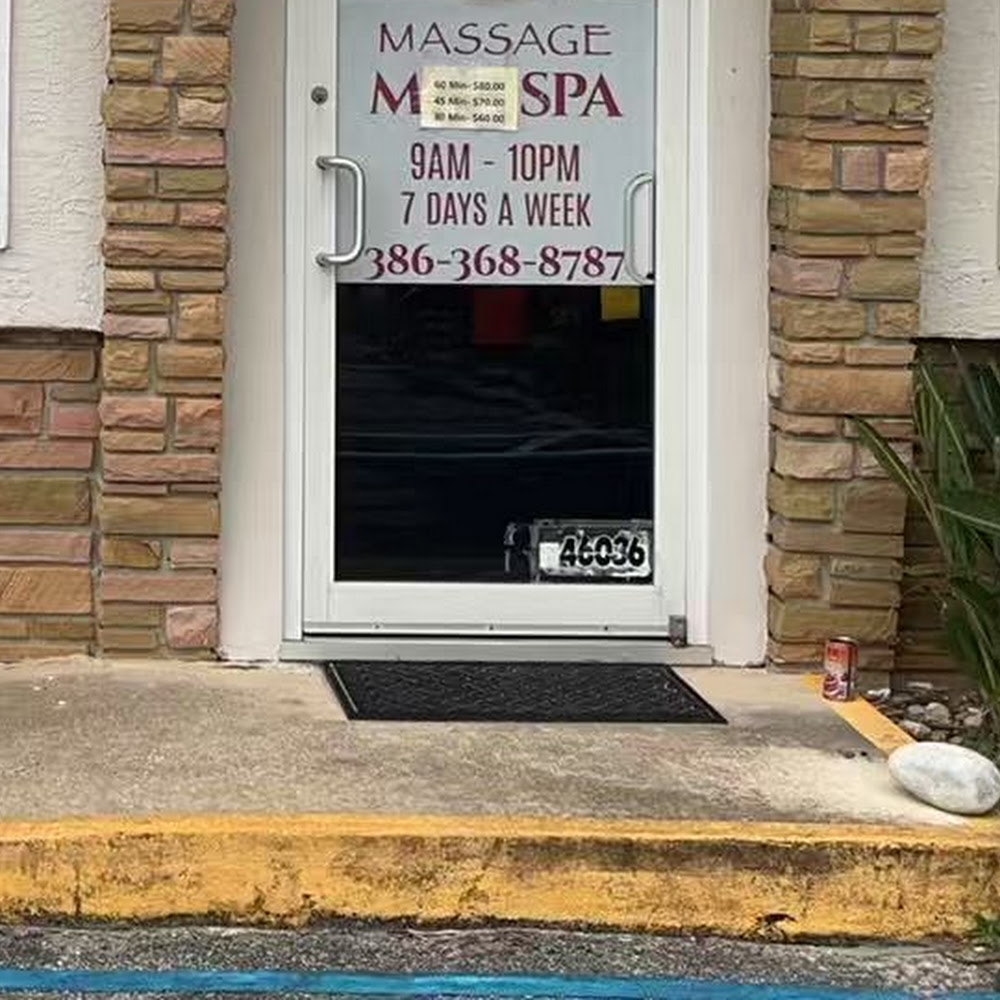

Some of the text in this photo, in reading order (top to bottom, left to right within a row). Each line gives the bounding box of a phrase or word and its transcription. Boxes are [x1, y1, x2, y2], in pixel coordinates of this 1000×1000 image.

[379, 22, 612, 55] MASSAGE
[521, 71, 622, 117] SPA
[410, 143, 470, 181] 9AM
[508, 144, 580, 182] 10PM
[401, 191, 592, 227] 7 DAYS A WEEK
[364, 243, 625, 281] 386-368-8787
[560, 536, 646, 567] 46036
